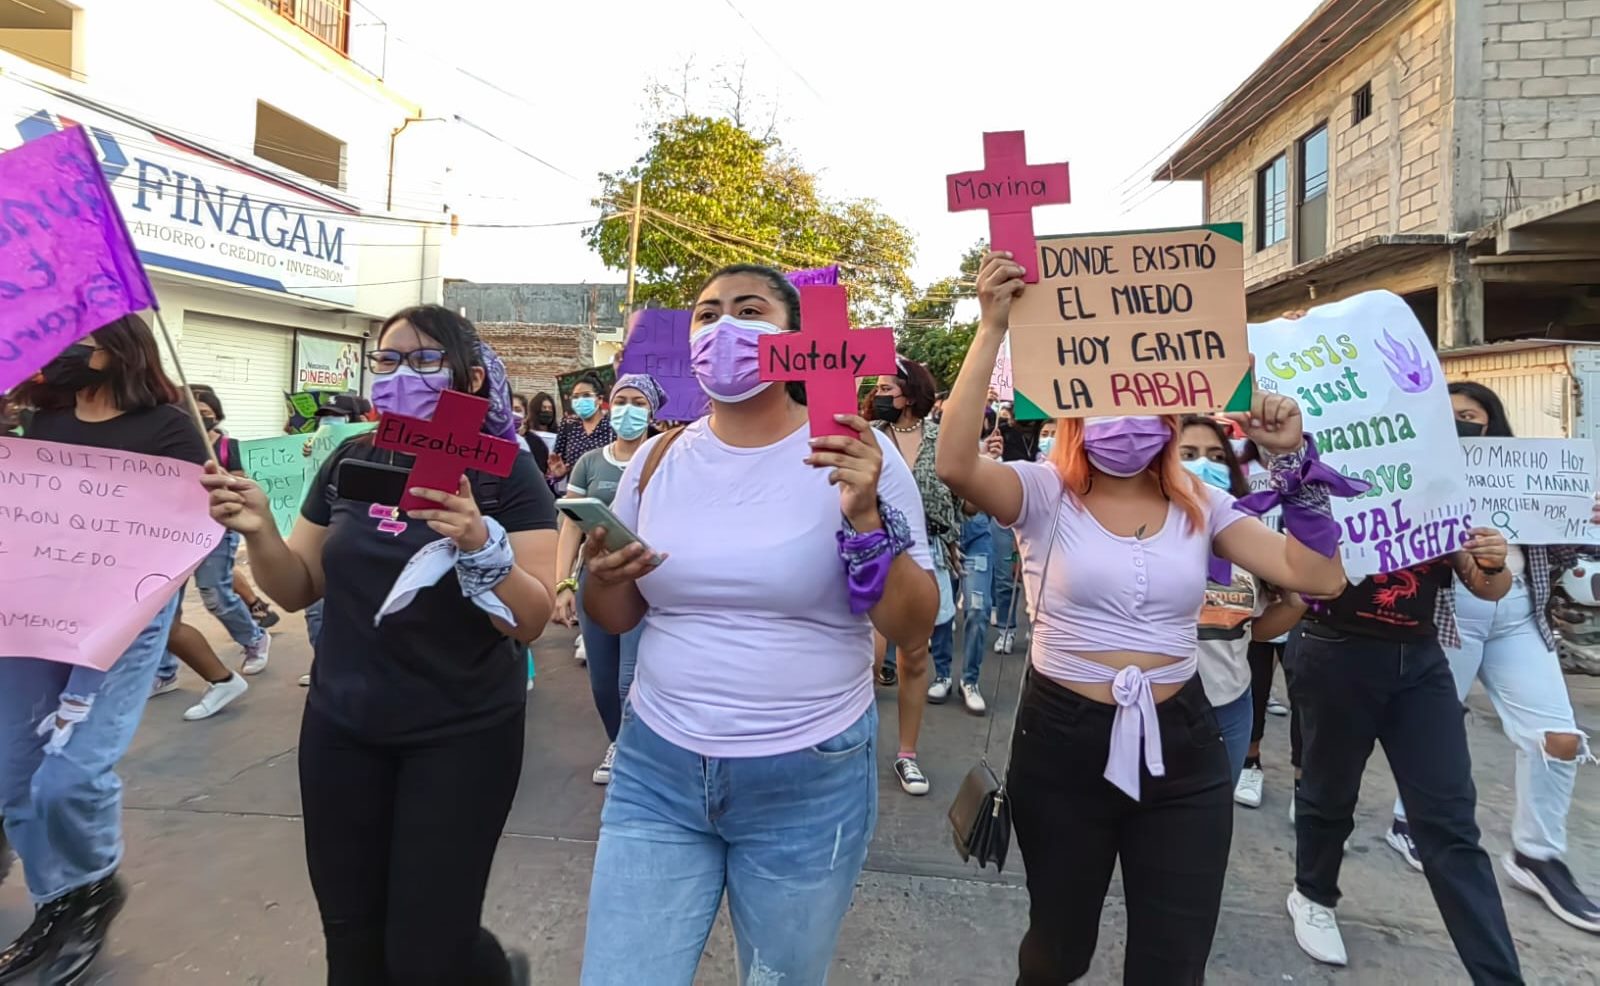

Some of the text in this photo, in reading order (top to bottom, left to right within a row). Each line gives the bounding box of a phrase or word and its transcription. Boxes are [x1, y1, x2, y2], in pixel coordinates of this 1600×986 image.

[953, 176, 1047, 204] Marina
[132, 157, 345, 265] FINAGAM
[133, 220, 206, 249] AHORRO
[1040, 232, 1216, 279] DONDE EXISTIÓ
[1057, 283, 1193, 320] EL MIEDO
[769, 340, 866, 375] Nataly
[1057, 329, 1225, 366] HOY GRITA
[1265, 334, 1359, 380] Girls
[1054, 378, 1093, 410] LA
[1296, 366, 1368, 417] just
[381, 418, 499, 465] Elizabeth
[1315, 413, 1417, 455] wanna
[36, 447, 181, 477] QUITARON
[1462, 444, 1584, 471] YO MARCHO HOY
[79, 479, 128, 498] QUE
[1527, 474, 1591, 493] MAÑANA
[1481, 497, 1540, 511] MARCHEN
[1544, 504, 1567, 519] POR
[69, 514, 213, 549] QUITANDONOS
[34, 546, 117, 567] MIEDO
